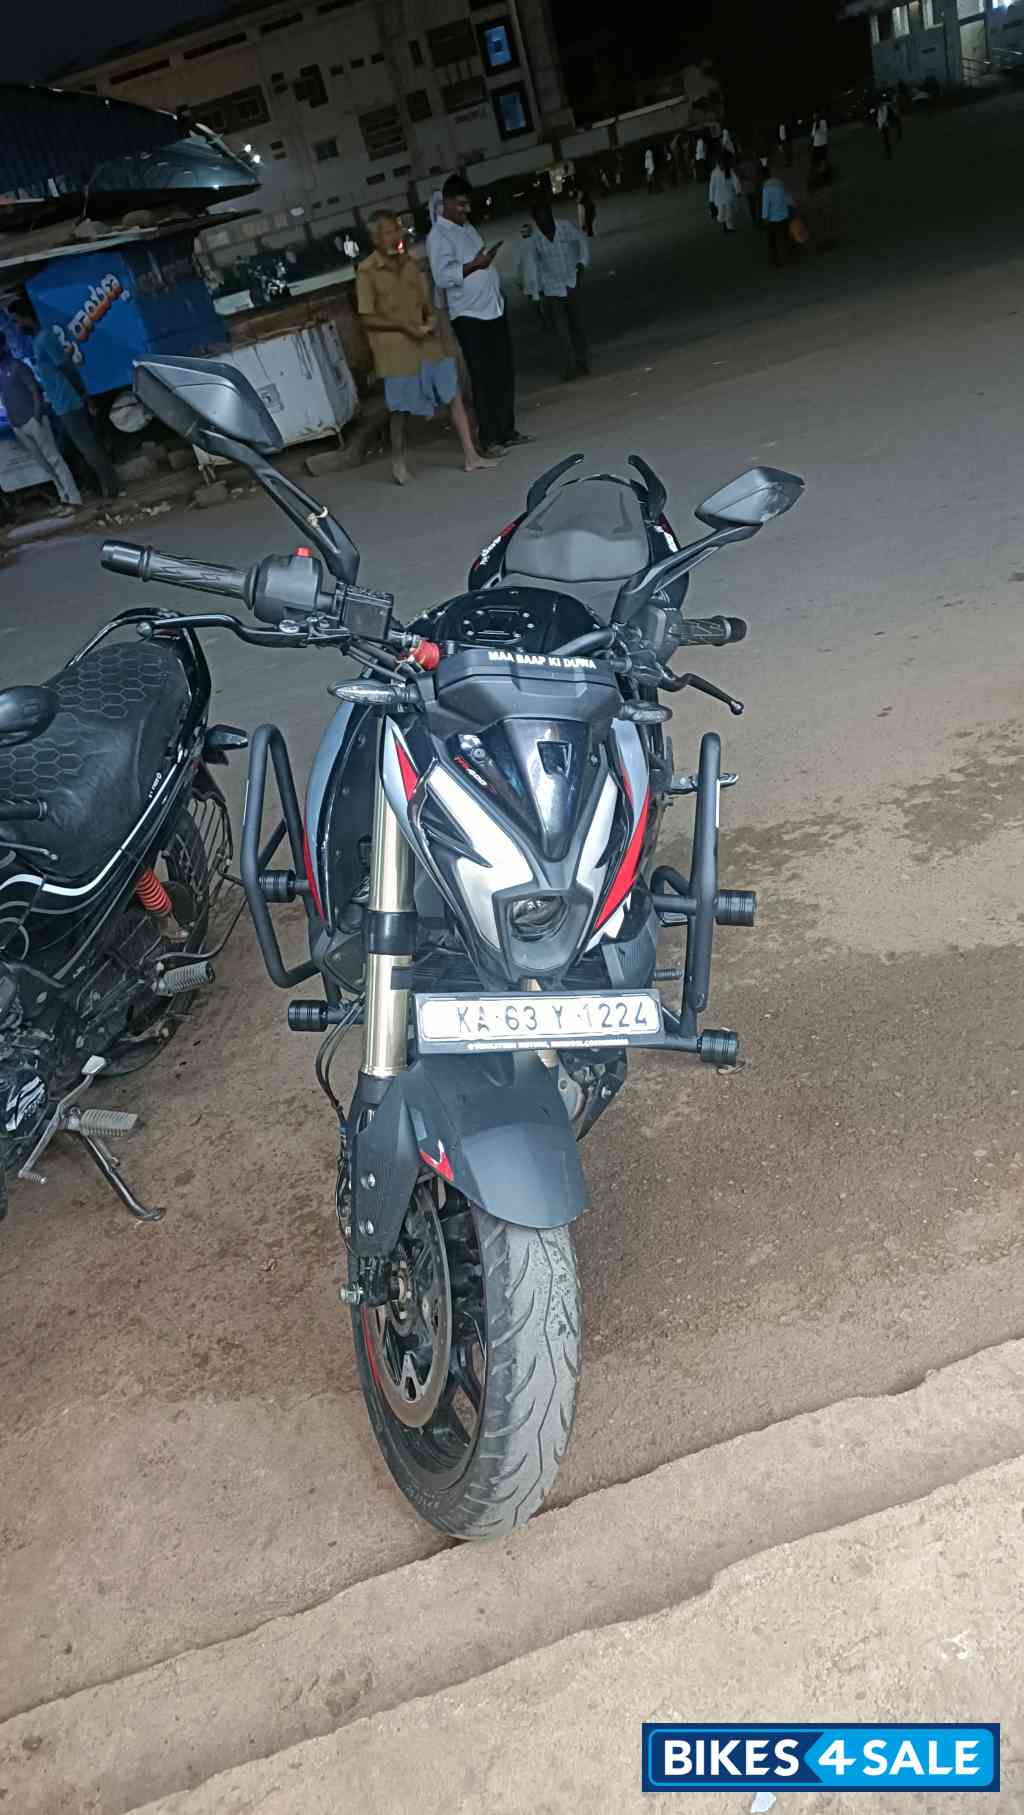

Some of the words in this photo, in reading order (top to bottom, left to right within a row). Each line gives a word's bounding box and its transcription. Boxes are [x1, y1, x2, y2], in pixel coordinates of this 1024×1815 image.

[488, 651, 514, 662] MAA
[548, 656, 562, 667] KI
[456, 1005, 490, 1033] KA
[504, 1005, 538, 1031] 63
[551, 1005, 563, 1029] Y
[583, 1001, 648, 1028] 1224
